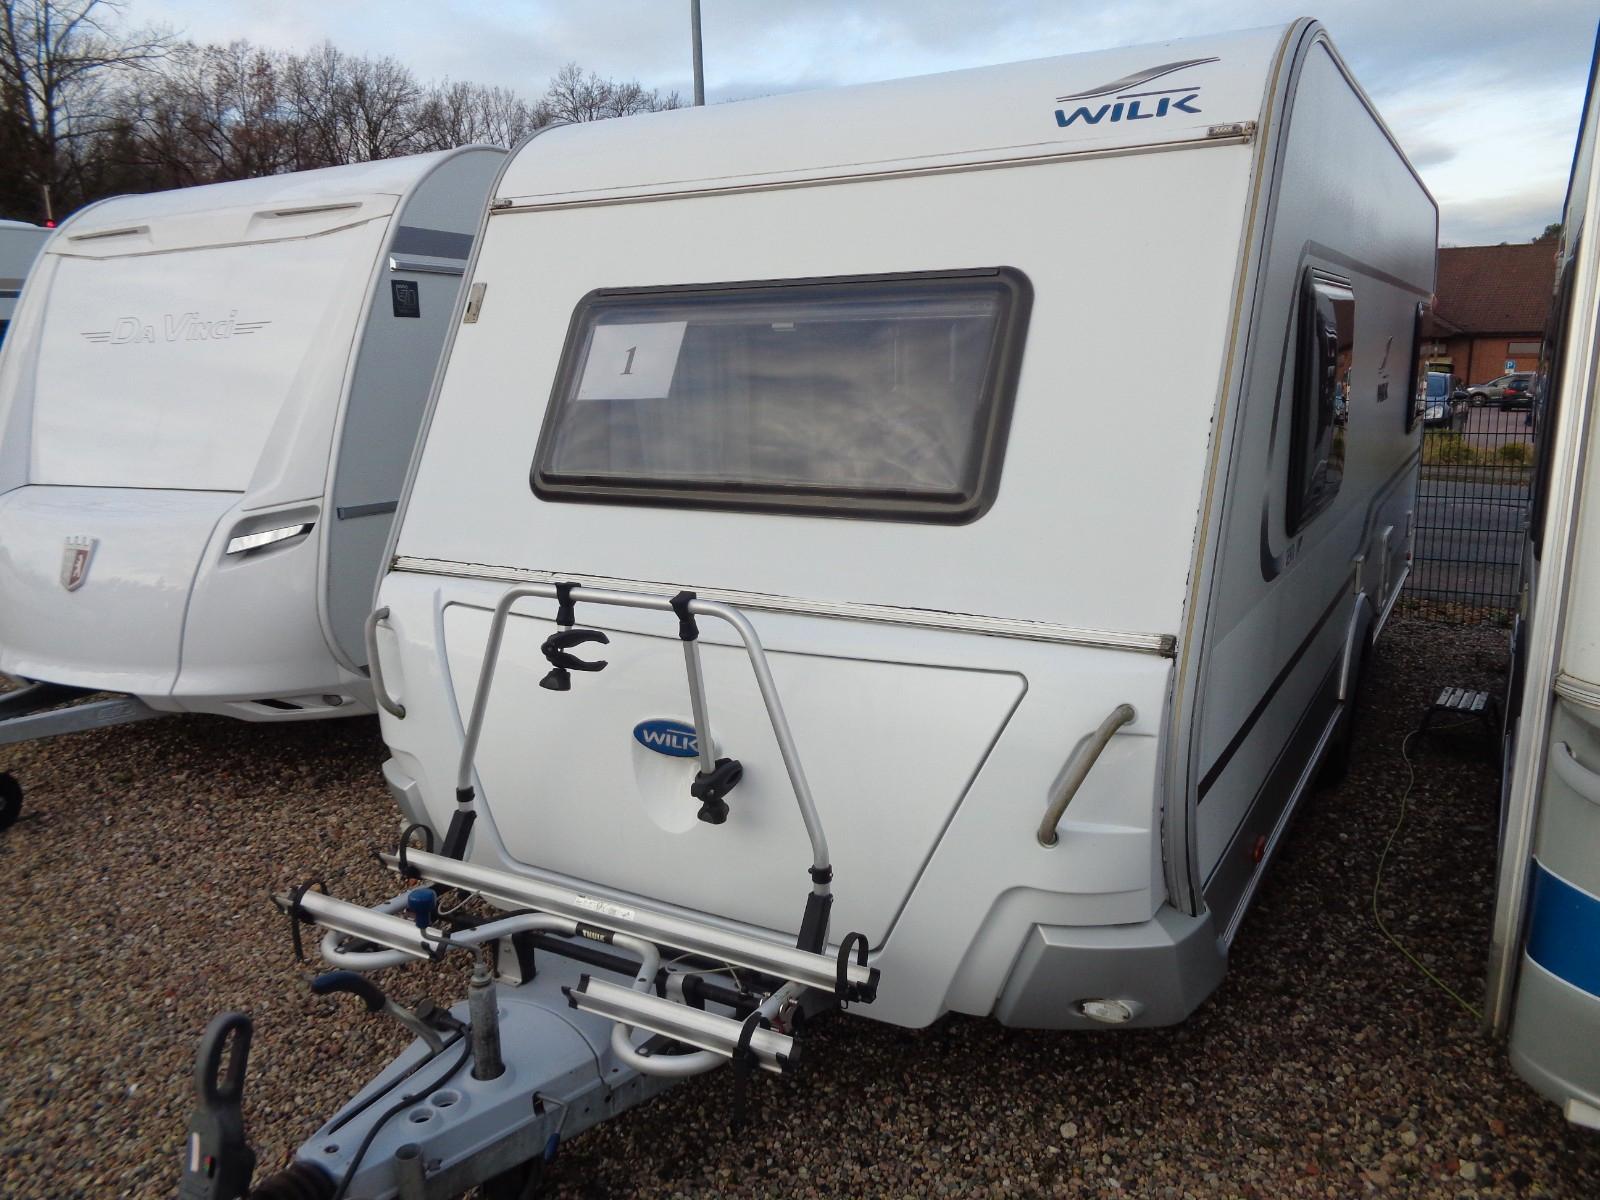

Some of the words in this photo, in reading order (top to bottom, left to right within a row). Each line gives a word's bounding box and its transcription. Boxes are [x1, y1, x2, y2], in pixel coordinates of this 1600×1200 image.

[1054, 93, 1202, 128] WILK
[619, 345, 637, 375] 1
[642, 729, 699, 752] WILK
